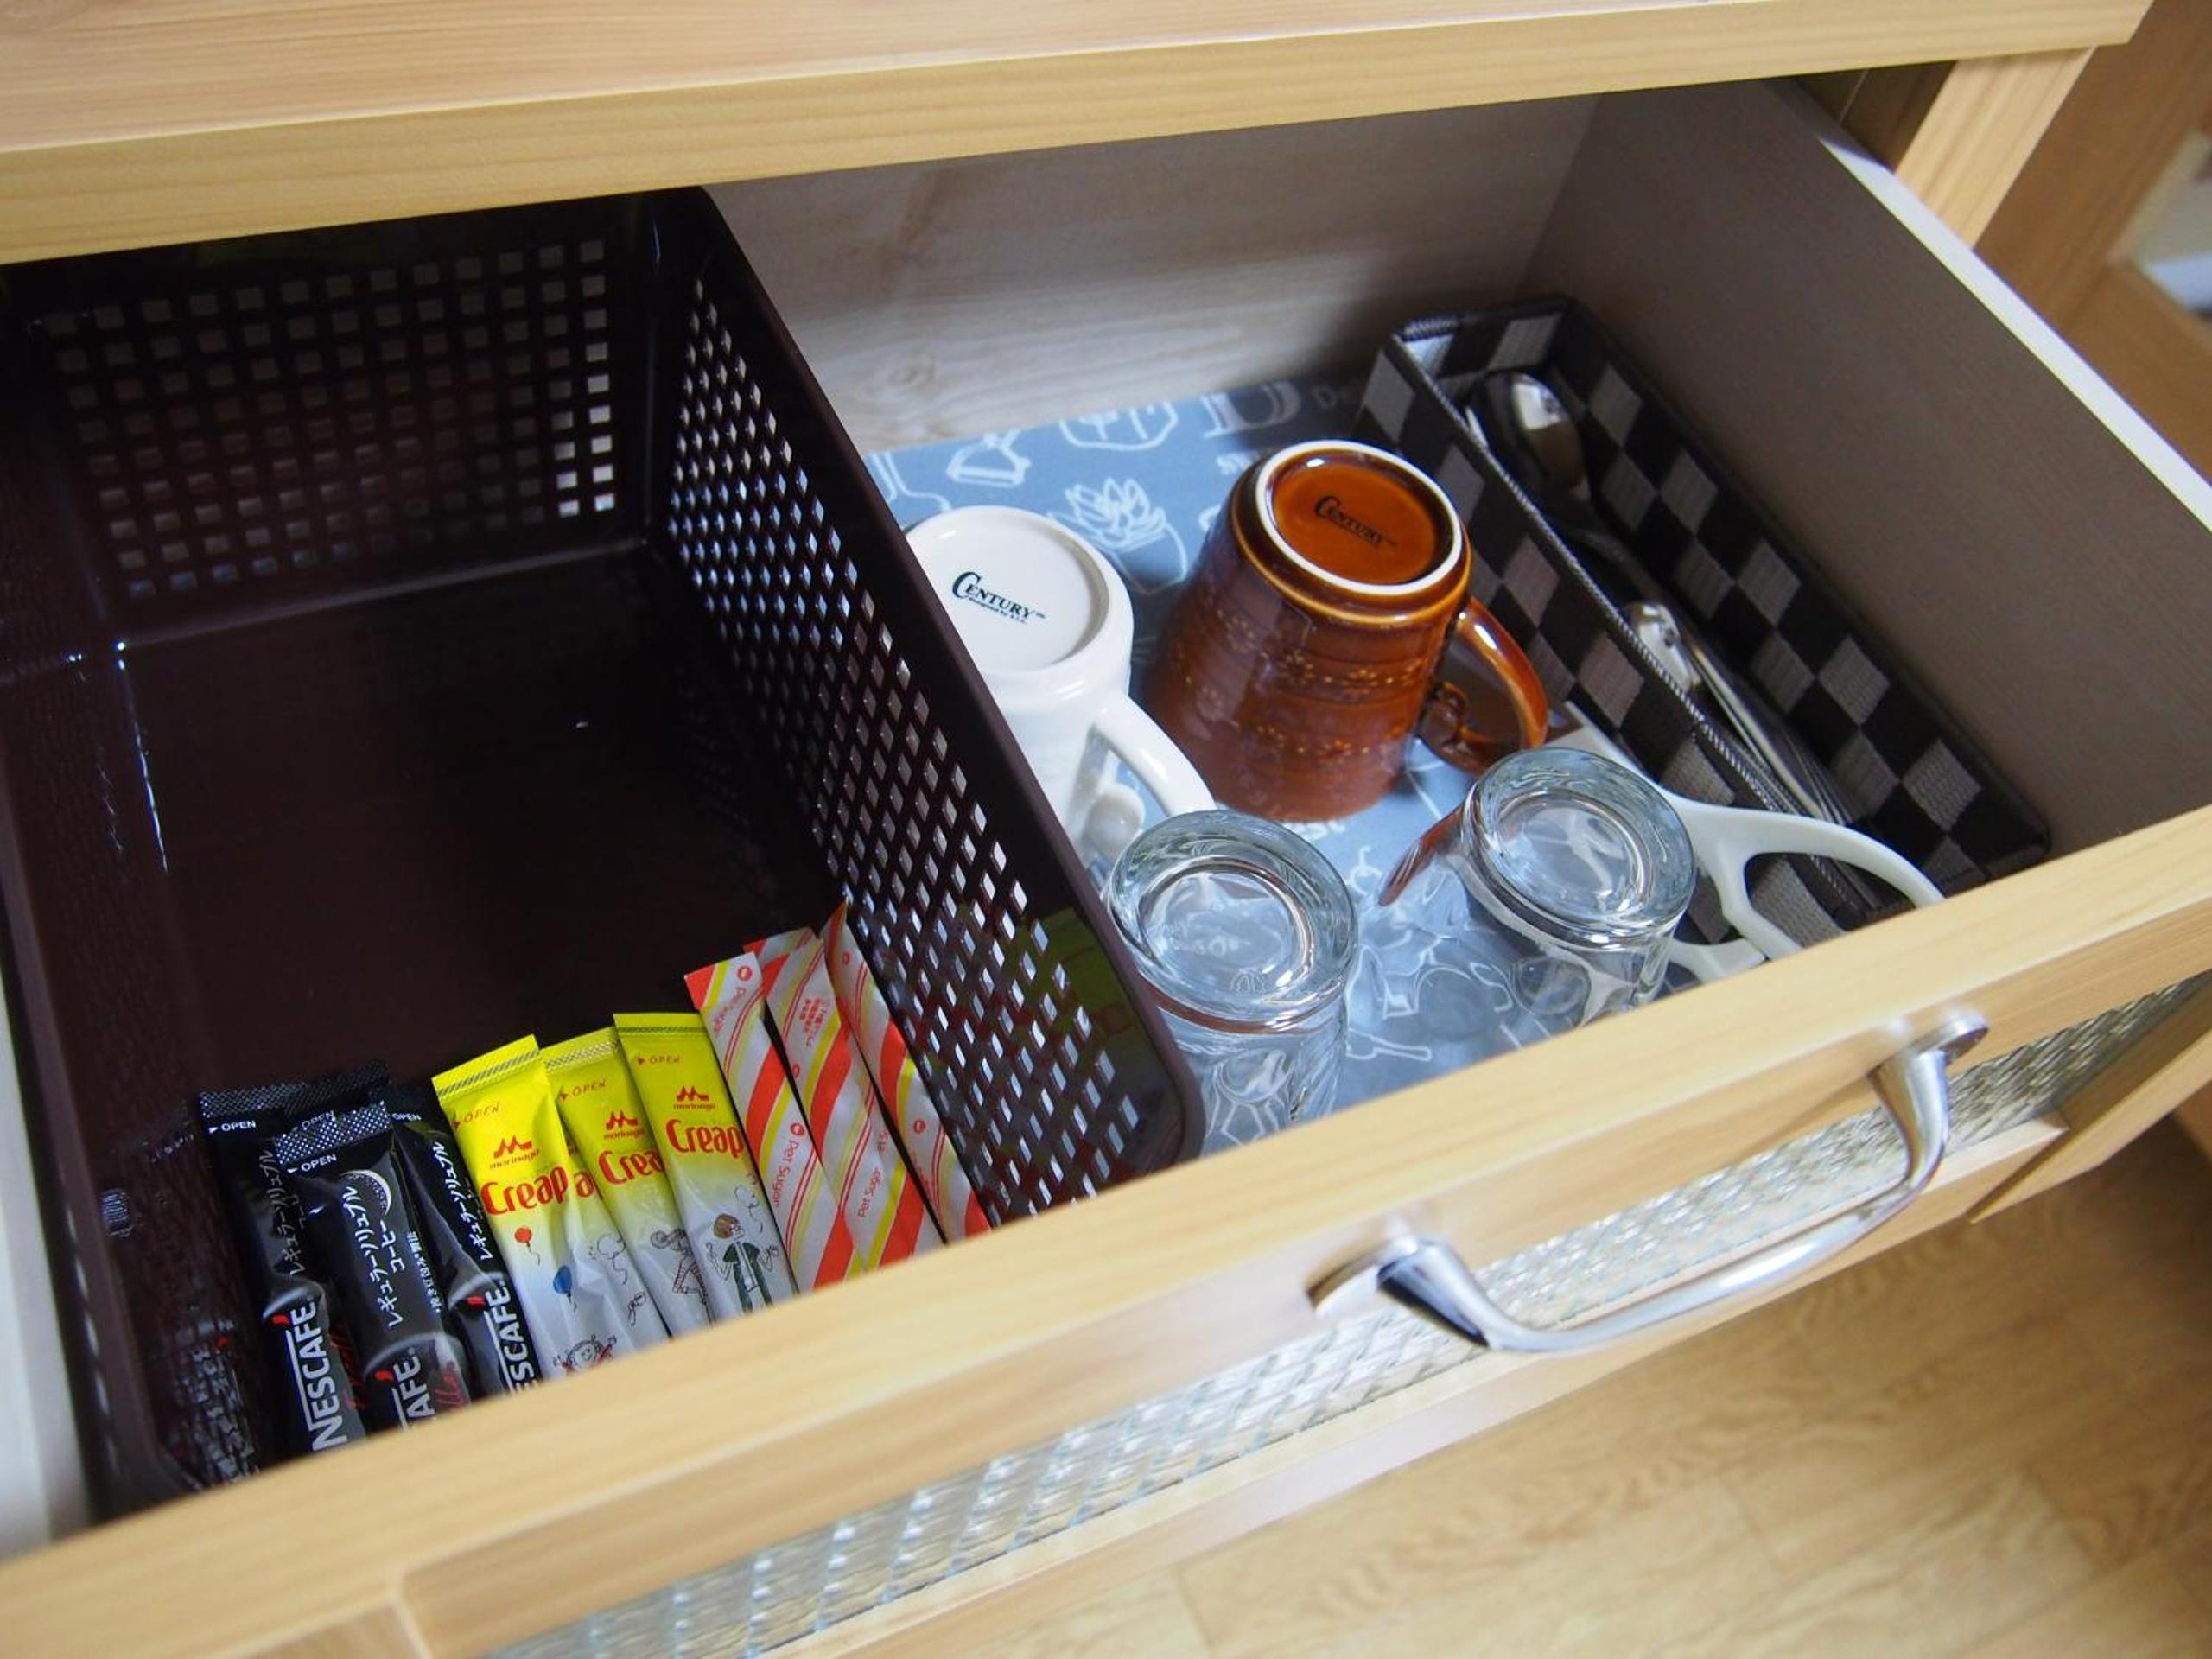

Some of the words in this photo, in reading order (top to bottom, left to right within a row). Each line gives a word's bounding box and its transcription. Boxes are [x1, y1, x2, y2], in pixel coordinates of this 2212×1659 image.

[951, 571, 1036, 619] CENTURY
[649, 1055, 681, 1065] OPEN
[572, 1077, 607, 1096] OPEN
[391, 1112, 422, 1122] OPEN
[463, 1101, 501, 1123] OPEN
[220, 1119, 257, 1133] OPEN
[665, 1118, 745, 1159] Creap
[301, 1154, 338, 1173] OPEN
[598, 1149, 665, 1186] Crea
[480, 1166, 569, 1216] Creap
[380, 1219, 406, 1274] コーヒー
